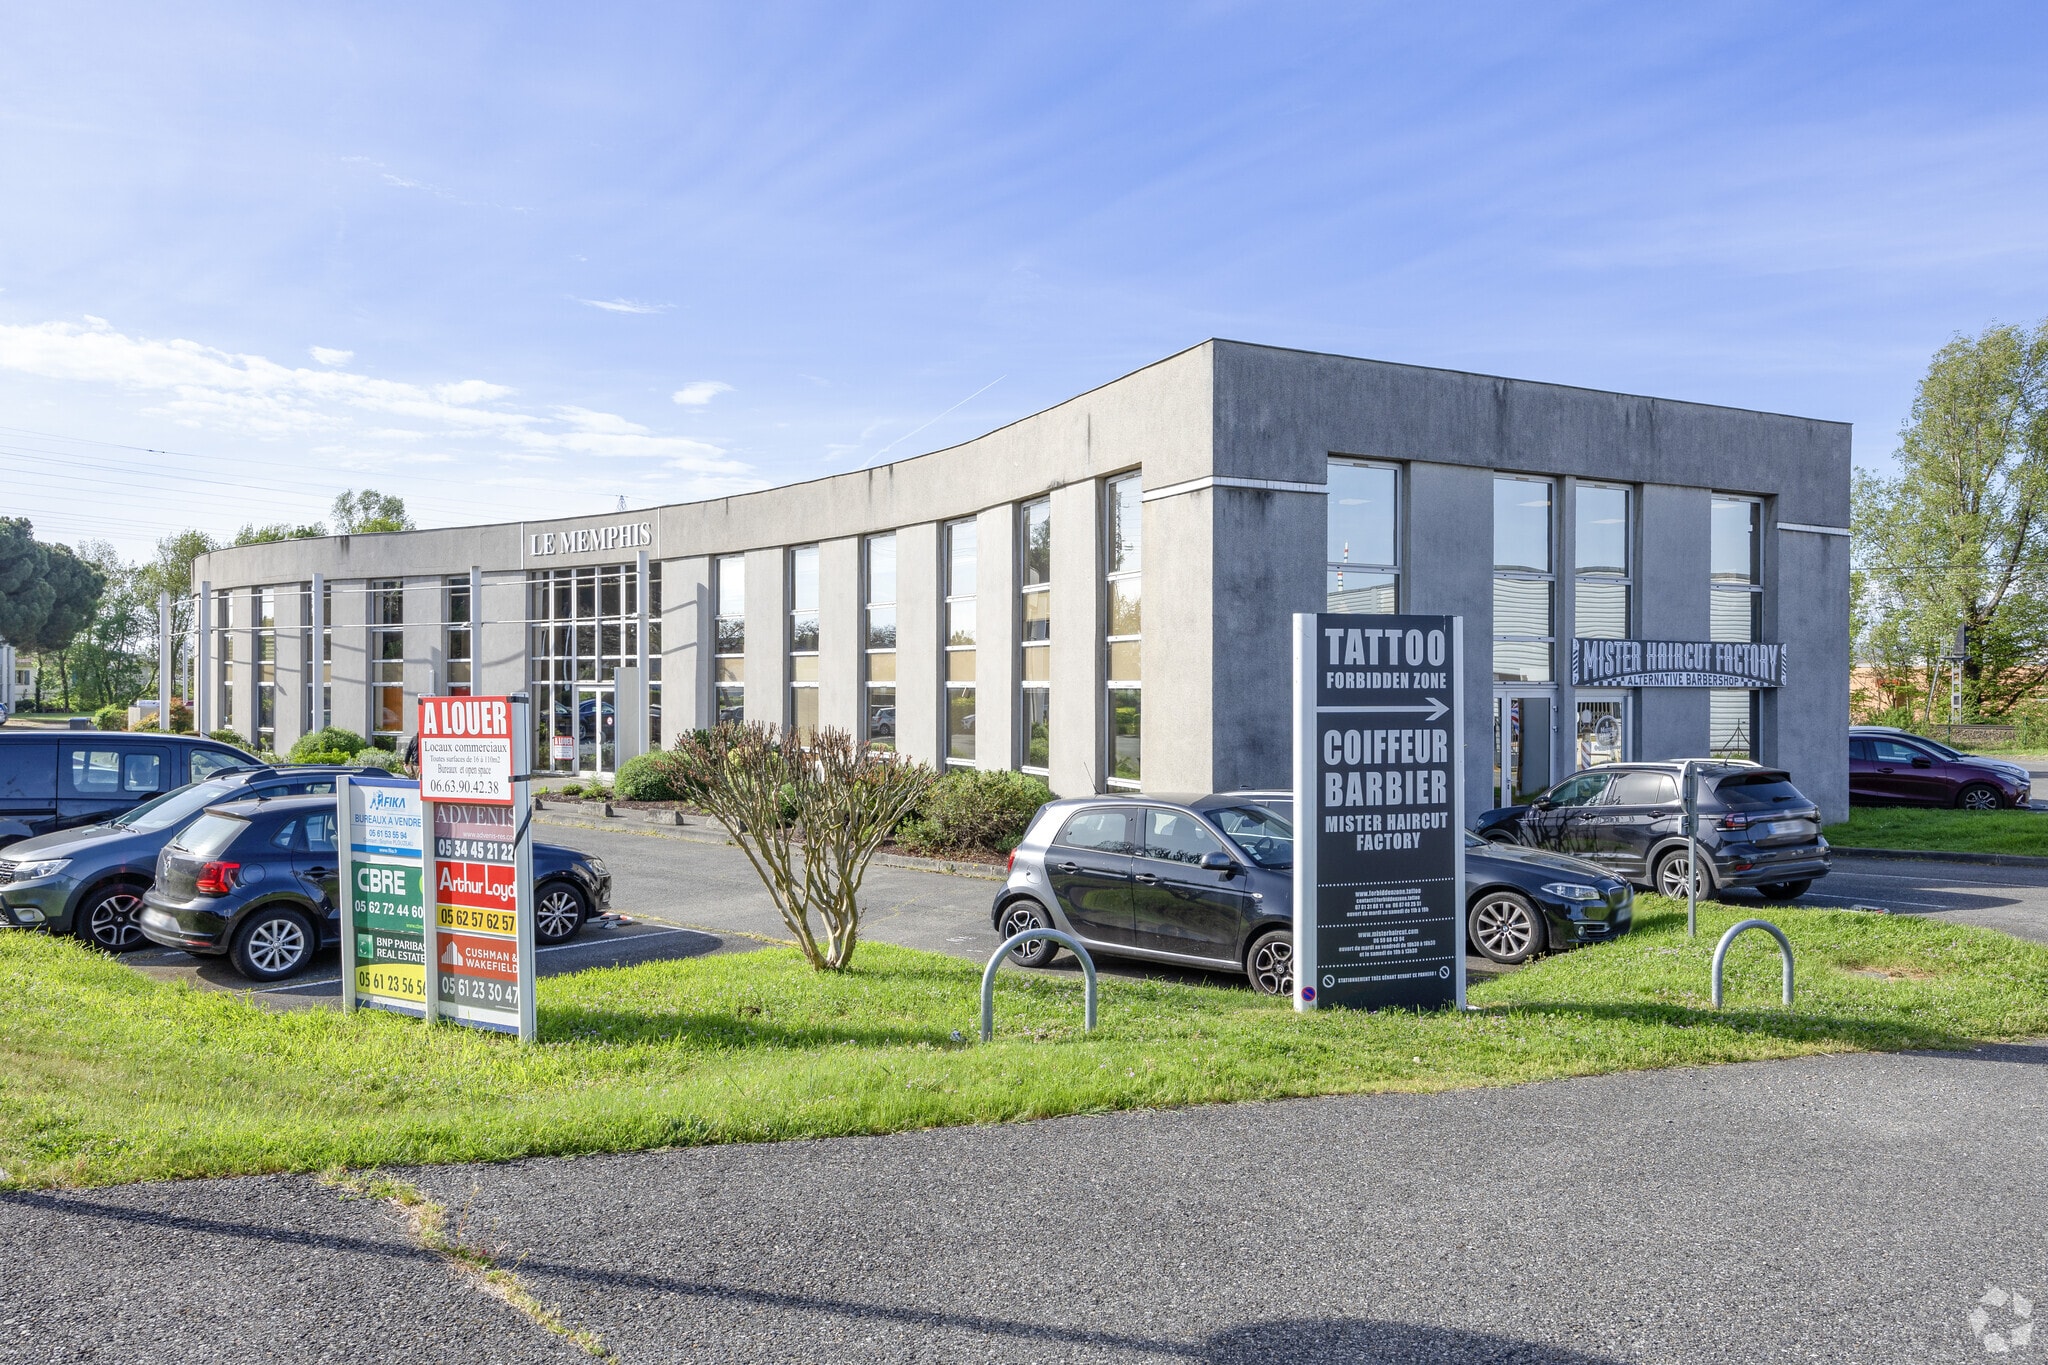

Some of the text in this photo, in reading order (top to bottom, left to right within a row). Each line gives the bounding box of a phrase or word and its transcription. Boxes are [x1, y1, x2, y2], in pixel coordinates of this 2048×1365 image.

[530, 522, 652, 556] LE MEMPHIS
[1324, 628, 1446, 666] TATTOO
[1583, 640, 1778, 682] MISTER HAIRCUT FACTORY
[1326, 672, 1446, 689] FORBIDDEN ZONE
[1627, 673, 1740, 686] ALTERNATIVE BARBERSHOP
[424, 701, 507, 735] A LOUER
[424, 741, 507, 752] Locaux commerciaux
[1324, 729, 1448, 766] COIFFEUR
[438, 764, 457, 774] Bureaux
[465, 767, 477, 777] open
[478, 767, 491, 777] space
[430, 780, 499, 794] 06.63.90.42.38
[1325, 770, 1446, 807] BARBIER
[355, 814, 386, 825] BUREAUX
[395, 817, 421, 827] VENDRE
[435, 804, 514, 827] ADVENIS
[1325, 812, 1448, 833] MISTER HAIRCUT
[439, 838, 514, 861] 05 34 45 21 22
[1356, 832, 1420, 851] FACTORY
[358, 868, 406, 896] CBRE
[440, 864, 516, 902] Arthur Loyd
[355, 900, 424, 918] 05 62 72 44 60
[441, 908, 515, 931] 05 62 57 62 57
[377, 937, 425, 952] BNP PARIBA
[377, 948, 425, 963] REAL ESTATE
[465, 947, 509, 961] CUSHMAN
[466, 958, 518, 973] WAKEFIELD
[360, 971, 370, 987] 05
[374, 973, 384, 989] 61
[388, 976, 399, 992] 23
[402, 978, 414, 994] 56
[442, 976, 519, 1004] 05 61 23 30 47
